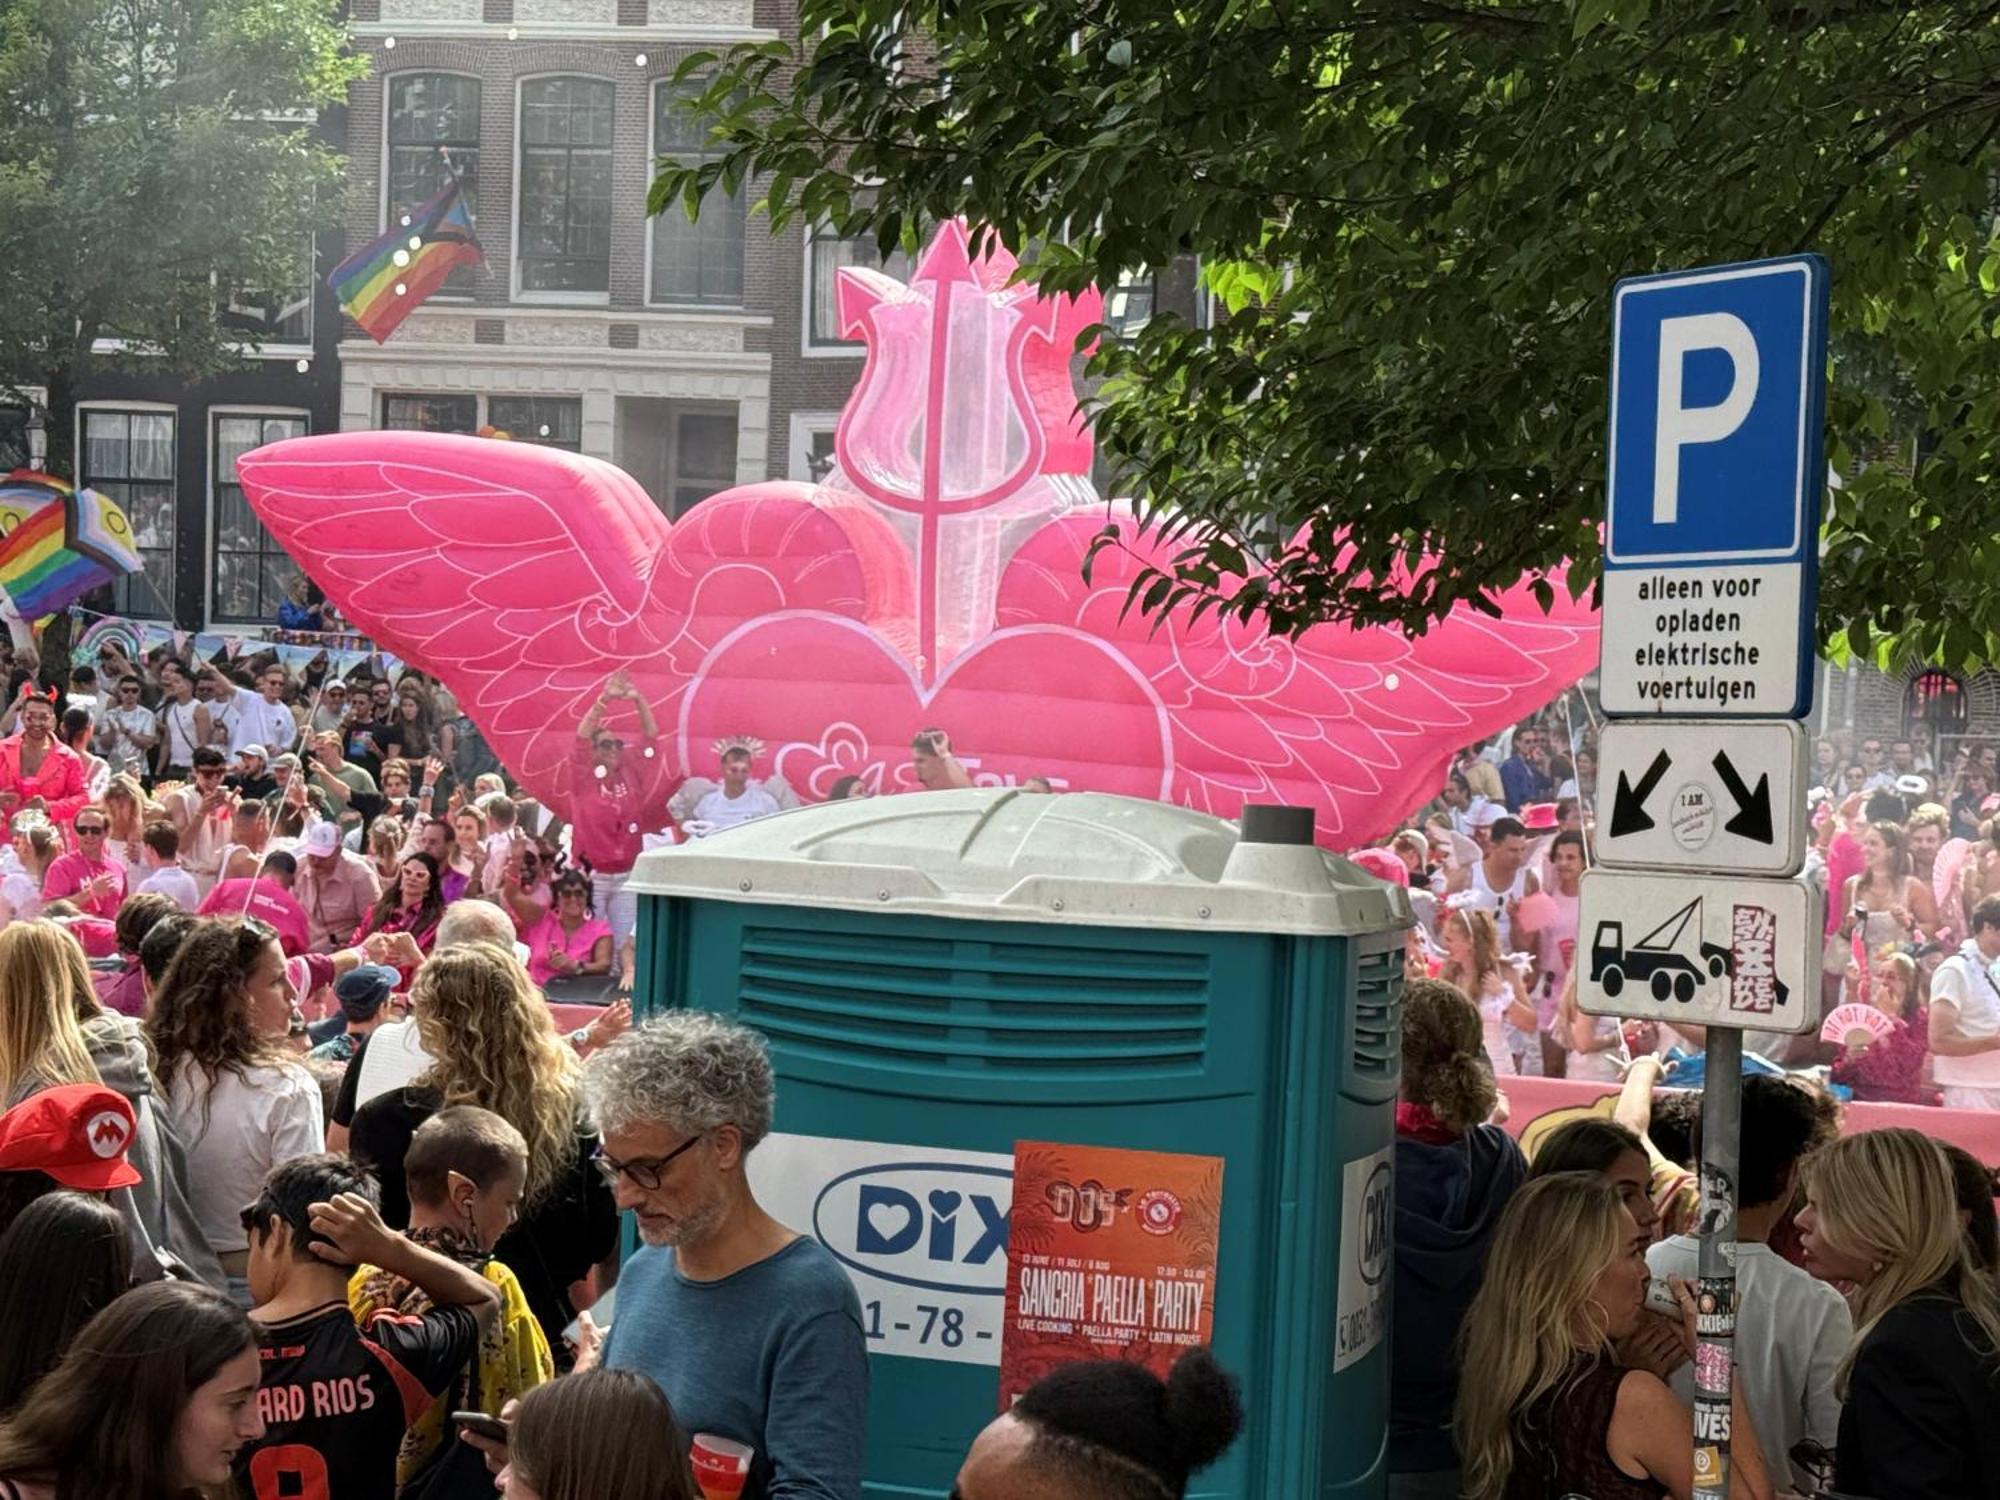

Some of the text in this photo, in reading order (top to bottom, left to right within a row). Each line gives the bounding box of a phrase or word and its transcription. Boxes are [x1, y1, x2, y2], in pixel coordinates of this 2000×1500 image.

[1652, 312, 1760, 524] P
[1638, 575, 1761, 600] alleen voor
[1656, 607, 1740, 637] opladen
[1635, 640, 1760, 666] elektrische
[1637, 675, 1756, 707] voertuigen
[93, 1119, 126, 1145] M
[1019, 1267, 1204, 1331] SANGRIA PAELLA PARTY
[1017, 1318, 1036, 1331] LIVE
[1082, 1324, 1112, 1338] PAELLA
[1113, 1327, 1140, 1341] PARTY
[1148, 1331, 1173, 1344] LATIN
[257, 1373, 375, 1423] ARD RIOS
